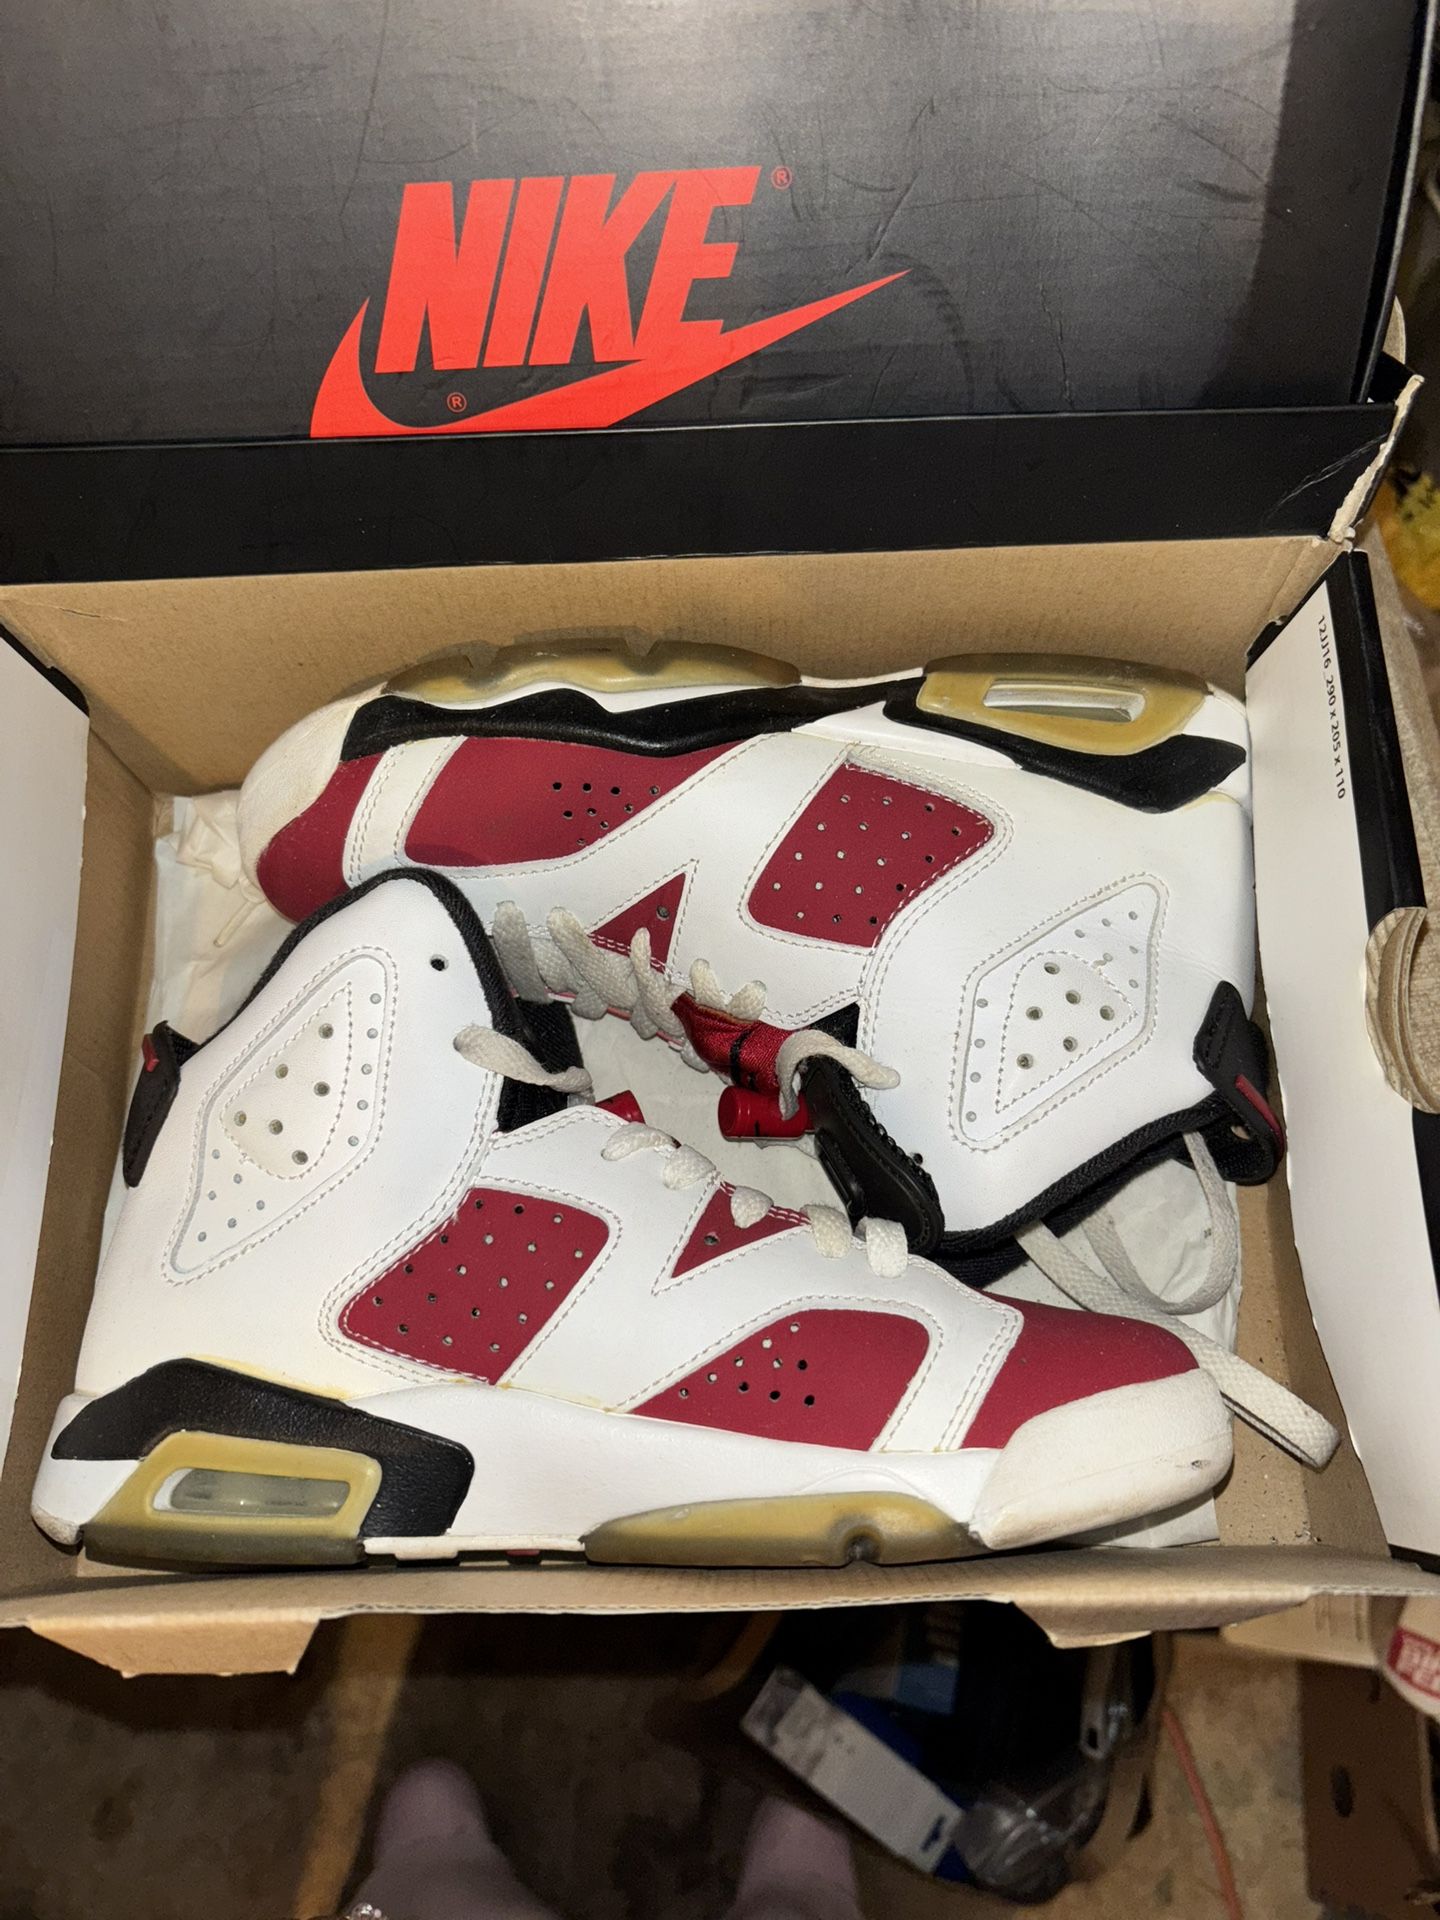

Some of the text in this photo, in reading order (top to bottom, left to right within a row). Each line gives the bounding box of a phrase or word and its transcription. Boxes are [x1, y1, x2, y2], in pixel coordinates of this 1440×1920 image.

[375, 165, 762, 374] NIKE
[1331, 720, 1342, 752] 205
[1336, 768, 1347, 800] 110
